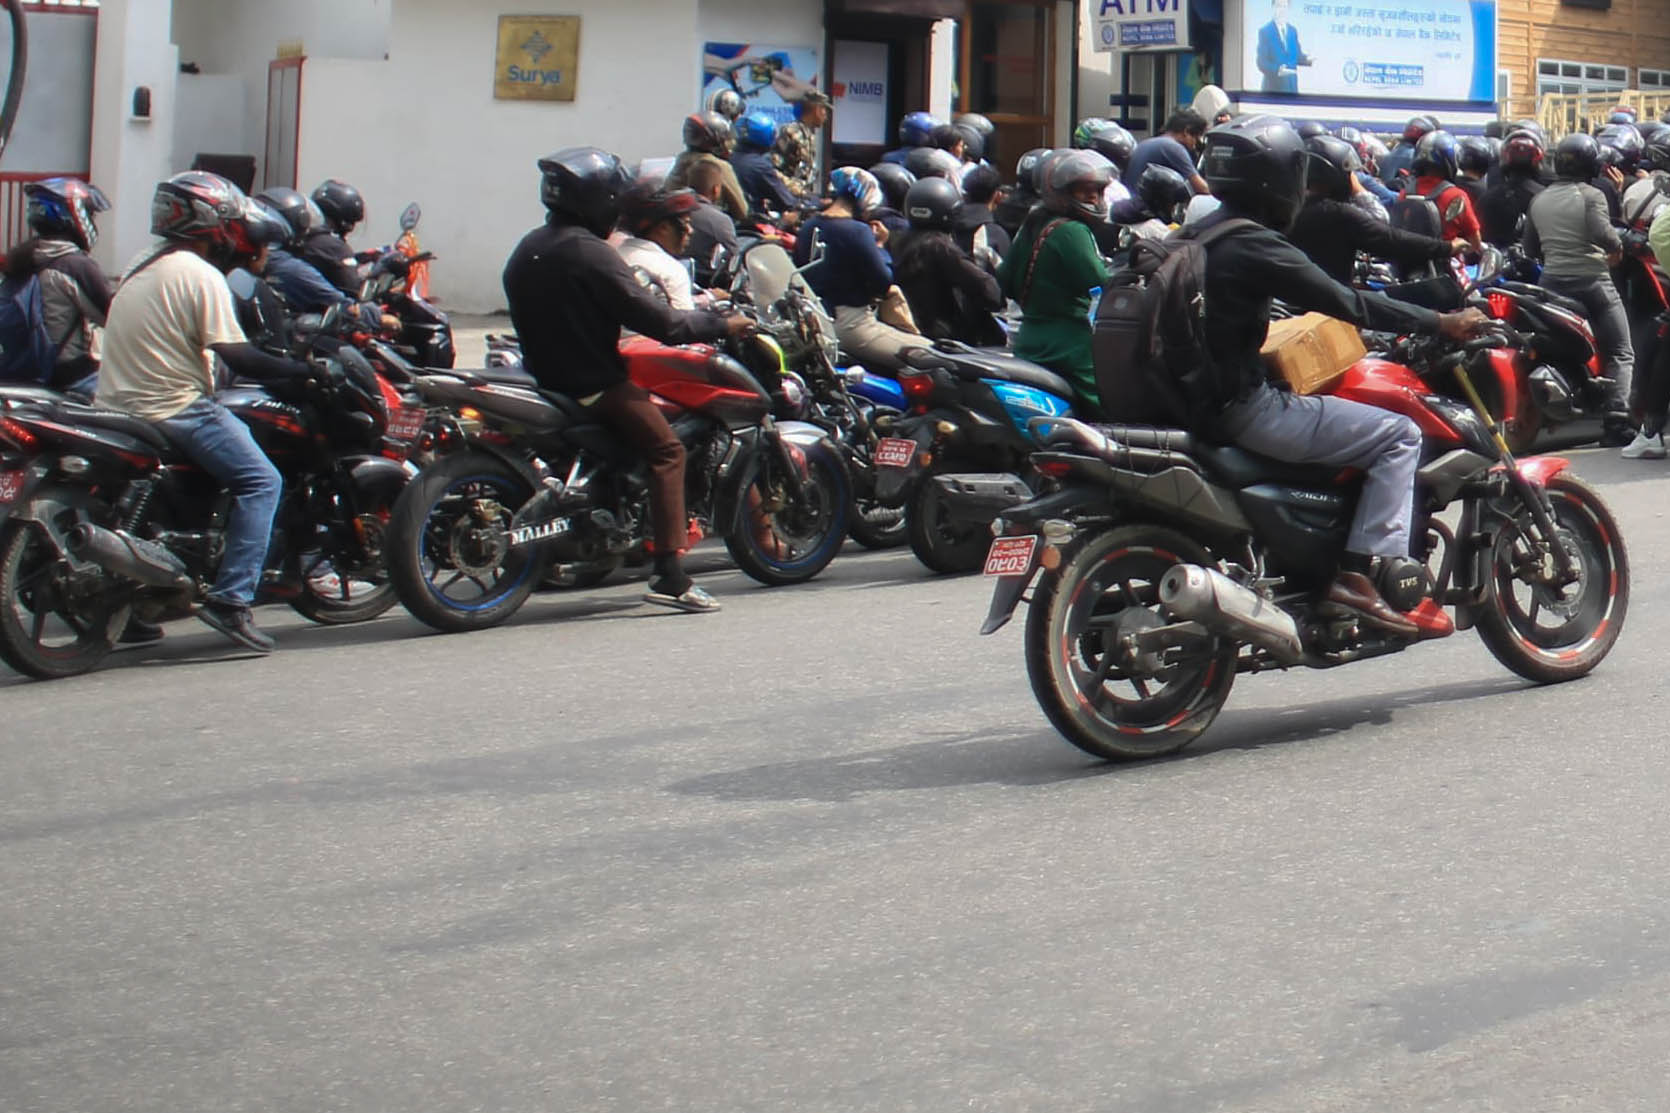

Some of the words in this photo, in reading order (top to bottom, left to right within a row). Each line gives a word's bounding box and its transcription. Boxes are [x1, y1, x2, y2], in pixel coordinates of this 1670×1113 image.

[507, 64, 561, 86] Surya
[849, 82, 883, 96] NIMB
[1399, 576, 1418, 588] TVS
